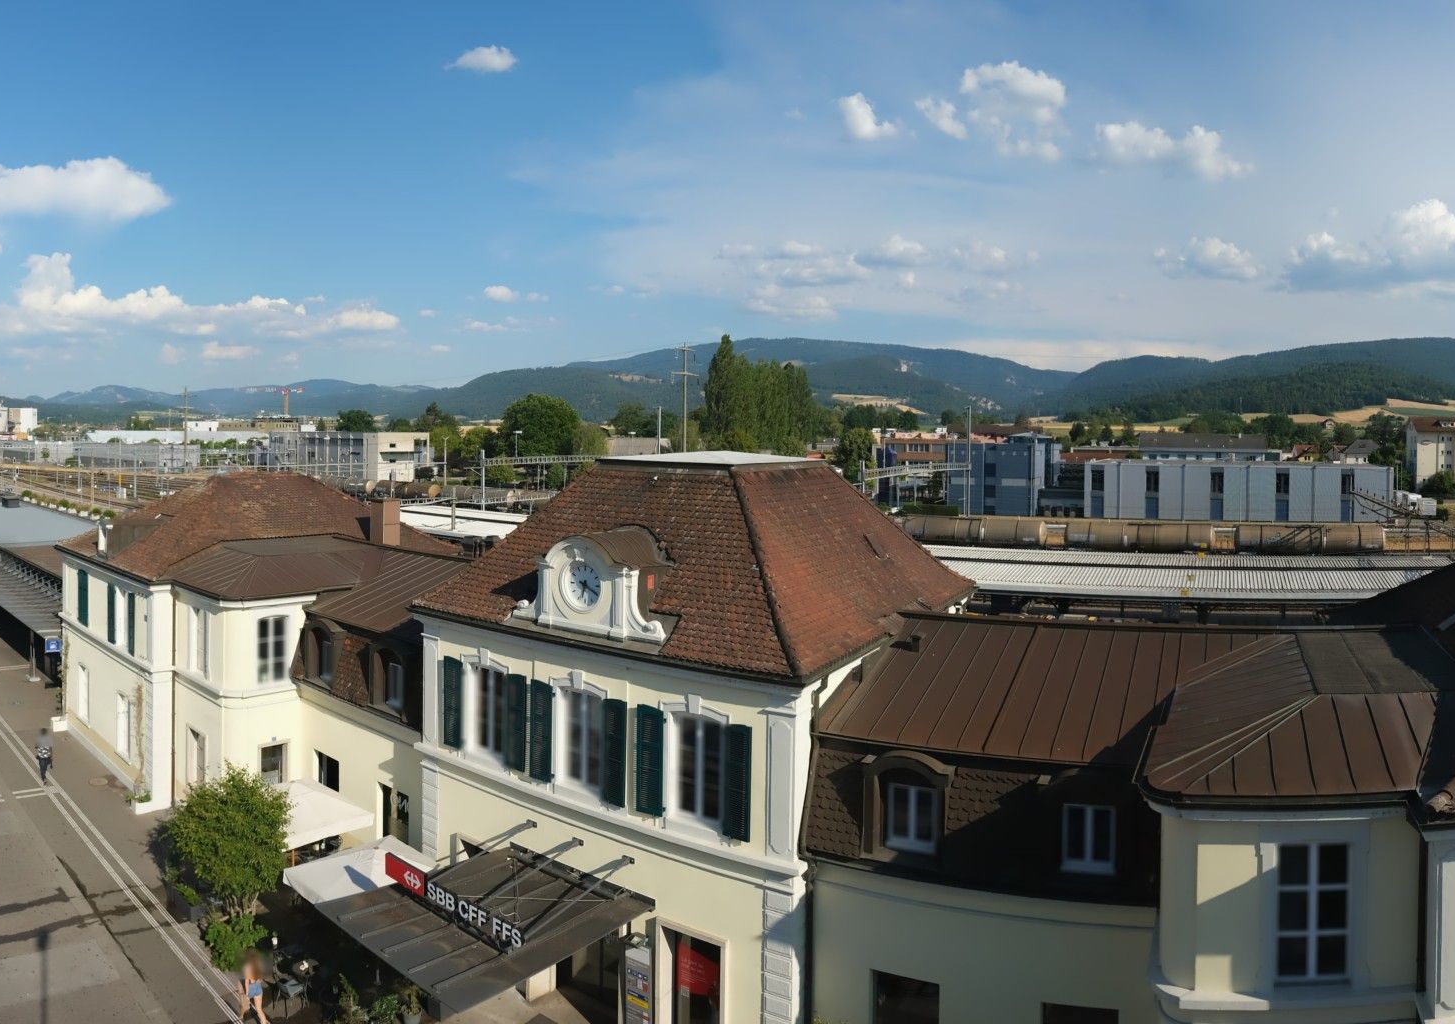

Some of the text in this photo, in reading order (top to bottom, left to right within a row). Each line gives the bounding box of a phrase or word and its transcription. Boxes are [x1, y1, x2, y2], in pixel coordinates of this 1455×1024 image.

[427, 882, 522, 948] SBB CFF FFS
